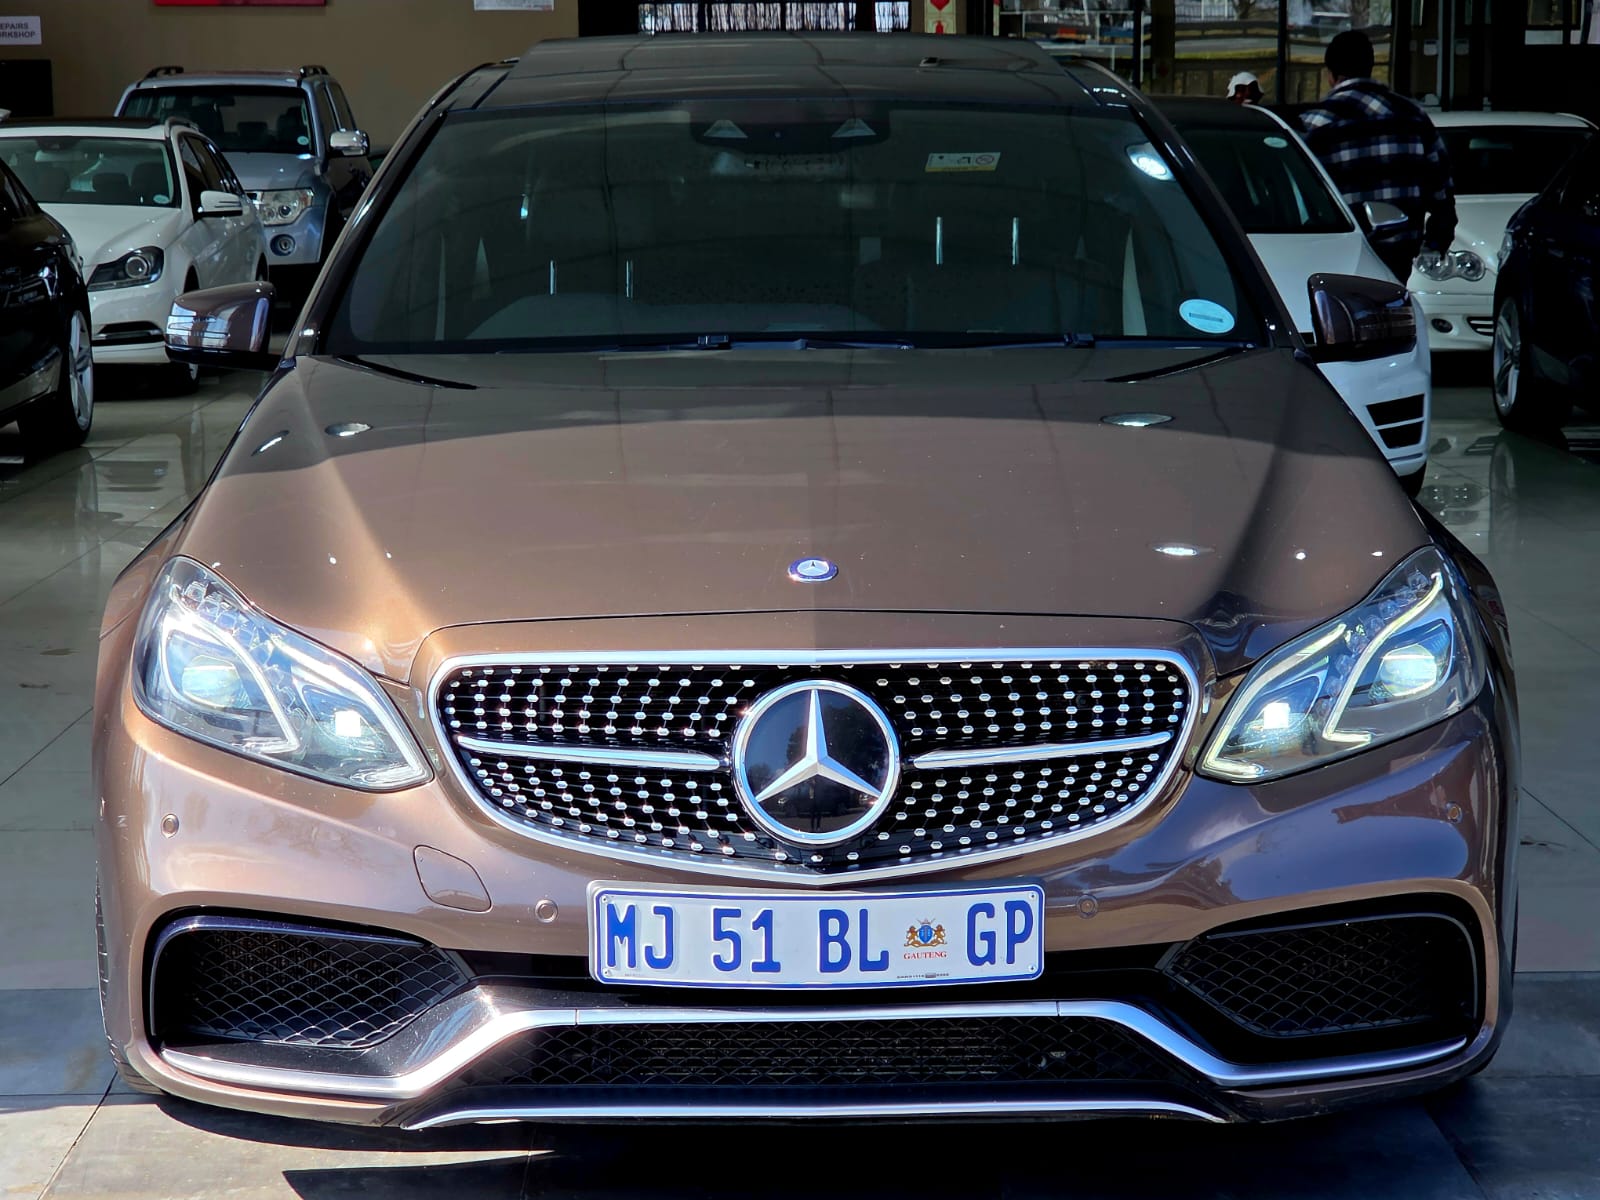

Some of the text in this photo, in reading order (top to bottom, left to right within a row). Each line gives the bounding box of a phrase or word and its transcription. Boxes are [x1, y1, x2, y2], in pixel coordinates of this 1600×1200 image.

[0, 22, 29, 30] EPAIRS
[606, 900, 1034, 973] MJ 51 BL GP
[903, 951, 947, 960] GAUTENG
